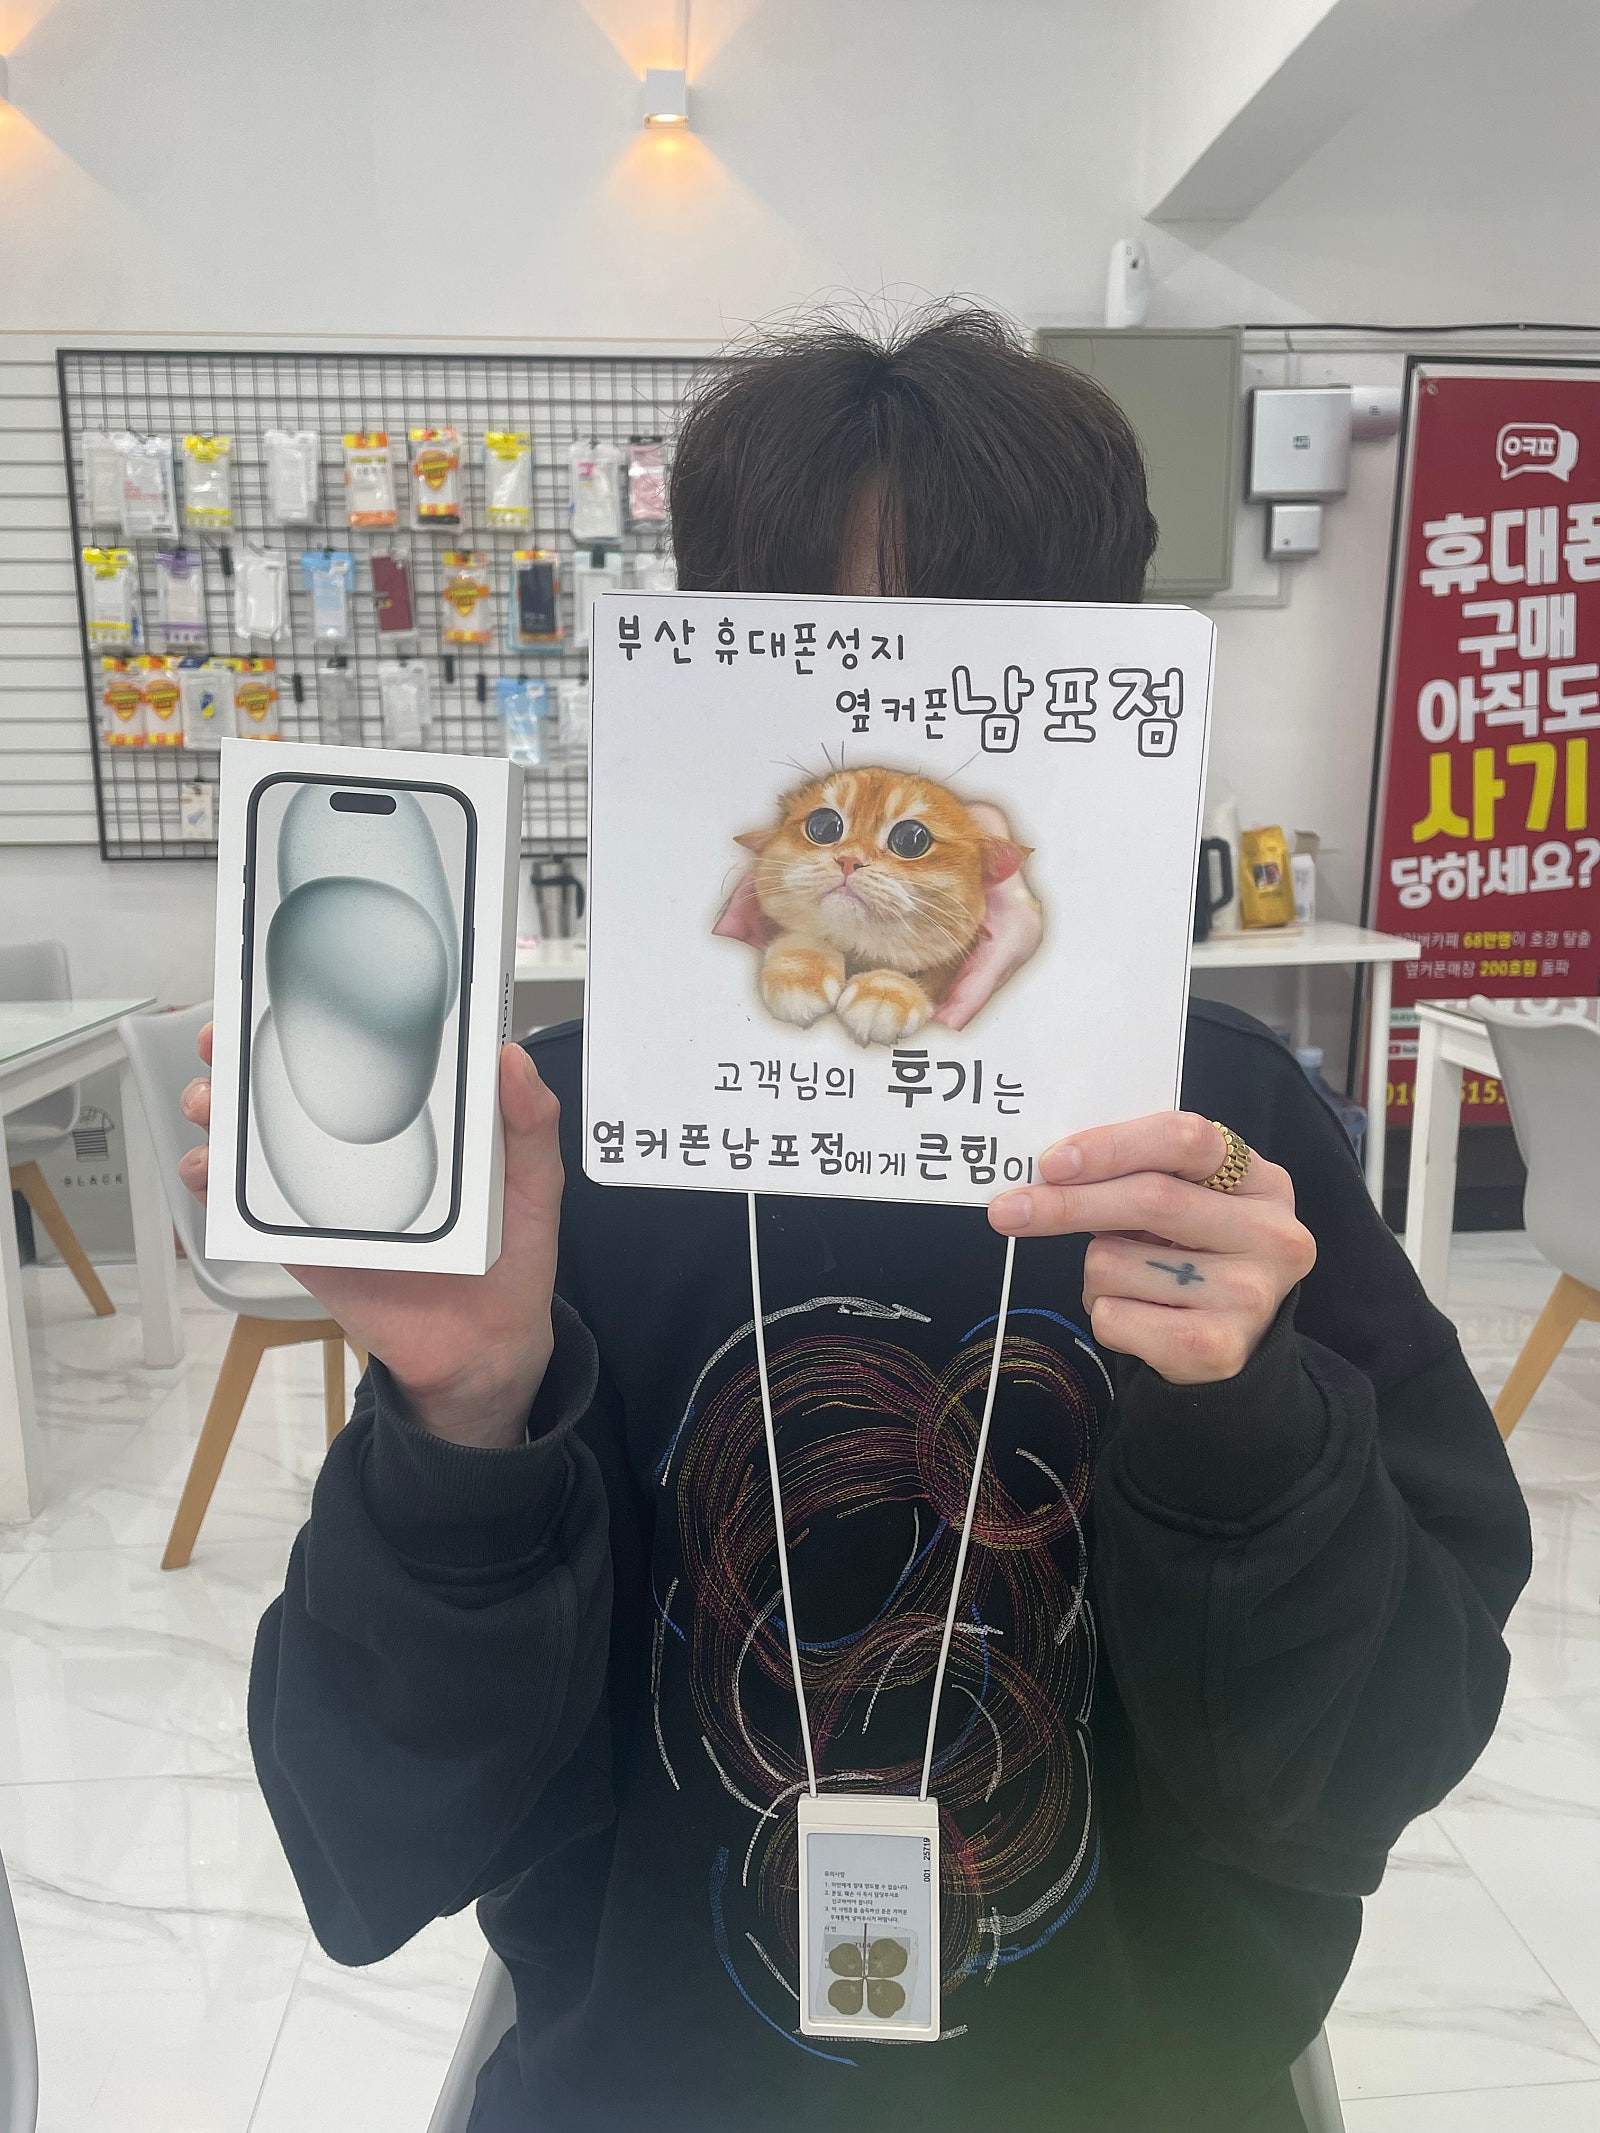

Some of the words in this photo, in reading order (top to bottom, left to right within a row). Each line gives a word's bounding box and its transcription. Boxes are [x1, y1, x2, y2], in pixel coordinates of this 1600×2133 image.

[617, 615, 695, 664] 부산
[715, 616, 905, 675] 휴대폰성지
[1457, 592, 1578, 668] 구매
[1416, 663, 1600, 744] 아직도
[1411, 737, 1589, 844] 사기
[1390, 838, 1600, 909] 당하세요?
[714, 1059, 855, 1101] 고객님의
[887, 1048, 1026, 1115] 후기는
[64, 1173, 123, 1188] BLACK
